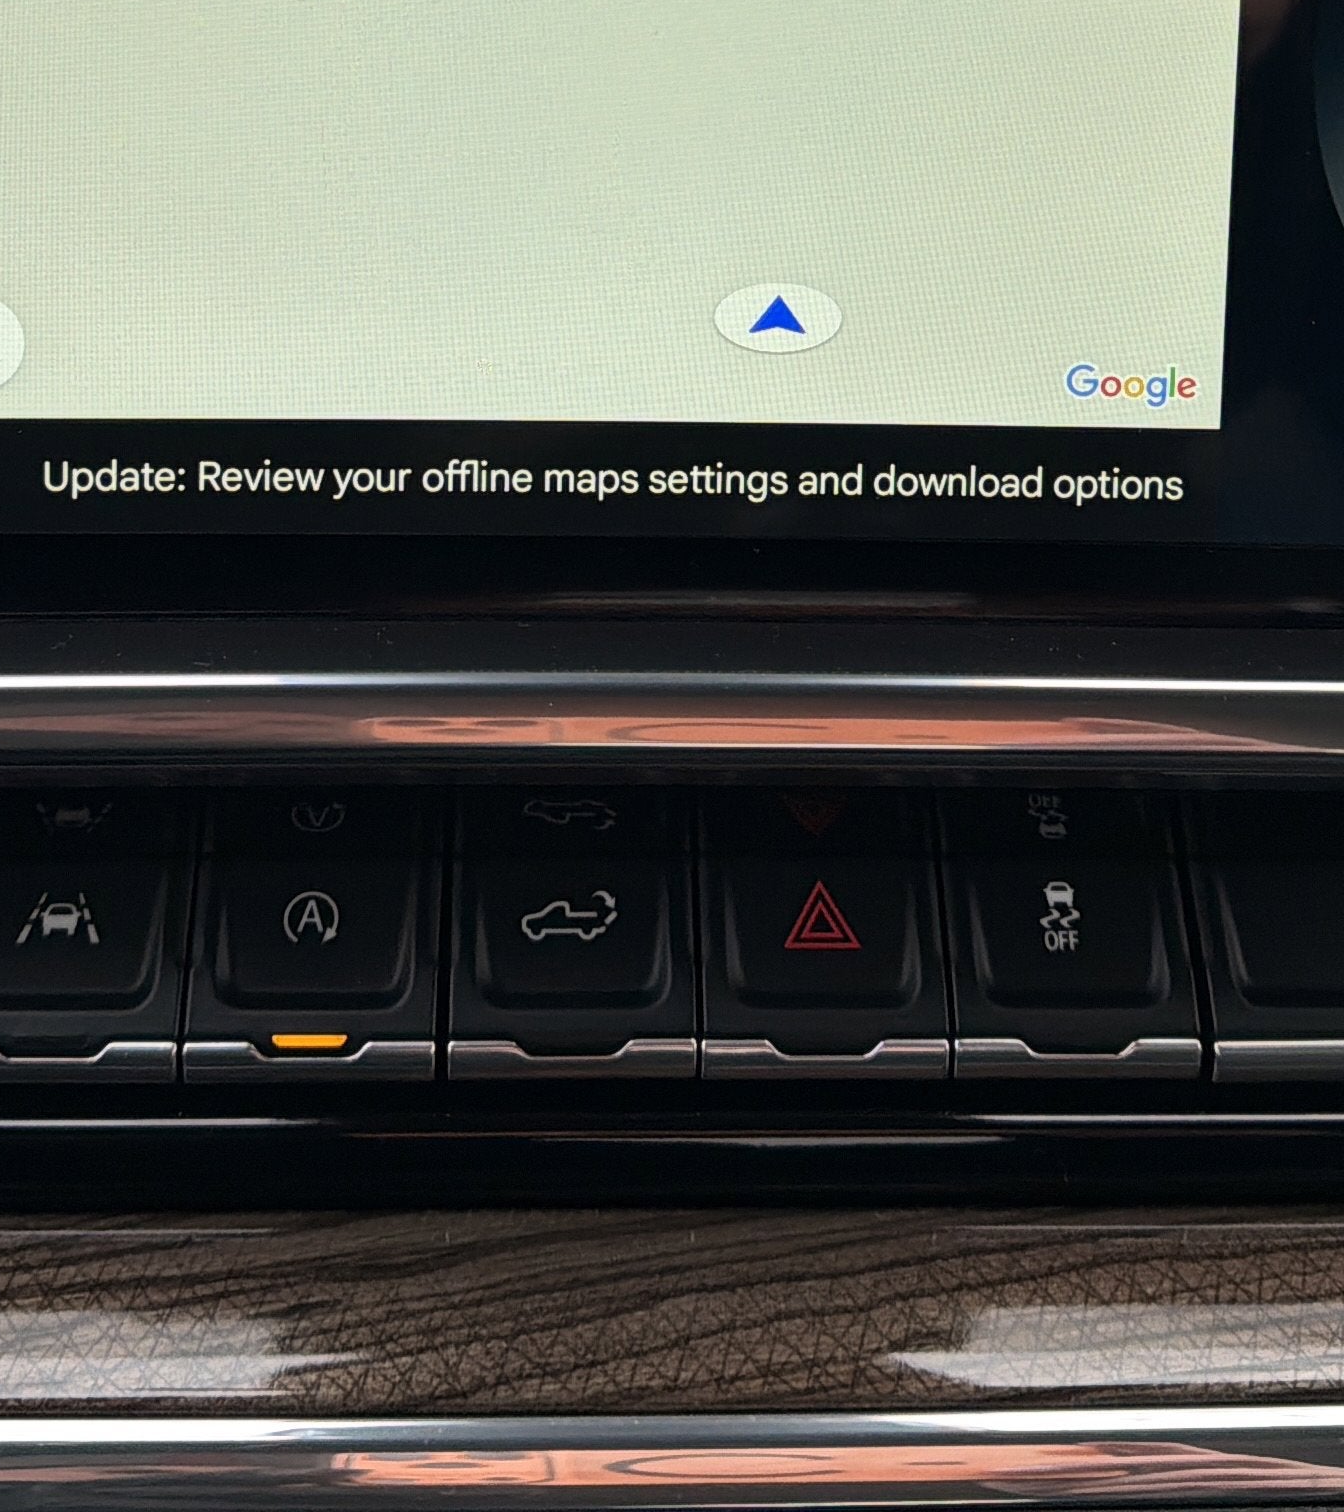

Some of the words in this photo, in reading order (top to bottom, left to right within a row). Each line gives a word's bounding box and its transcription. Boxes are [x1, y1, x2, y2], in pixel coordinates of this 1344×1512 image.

[1065, 363, 1198, 409] Google
[43, 458, 186, 500] Update:
[198, 458, 326, 492] Review
[332, 468, 413, 500] your
[421, 458, 533, 493] offline
[544, 469, 640, 502] maps
[648, 461, 789, 504] settings
[798, 463, 863, 496] and
[873, 463, 1044, 499] download
[1053, 466, 1184, 507] options
[1044, 930, 1079, 952] OFF
